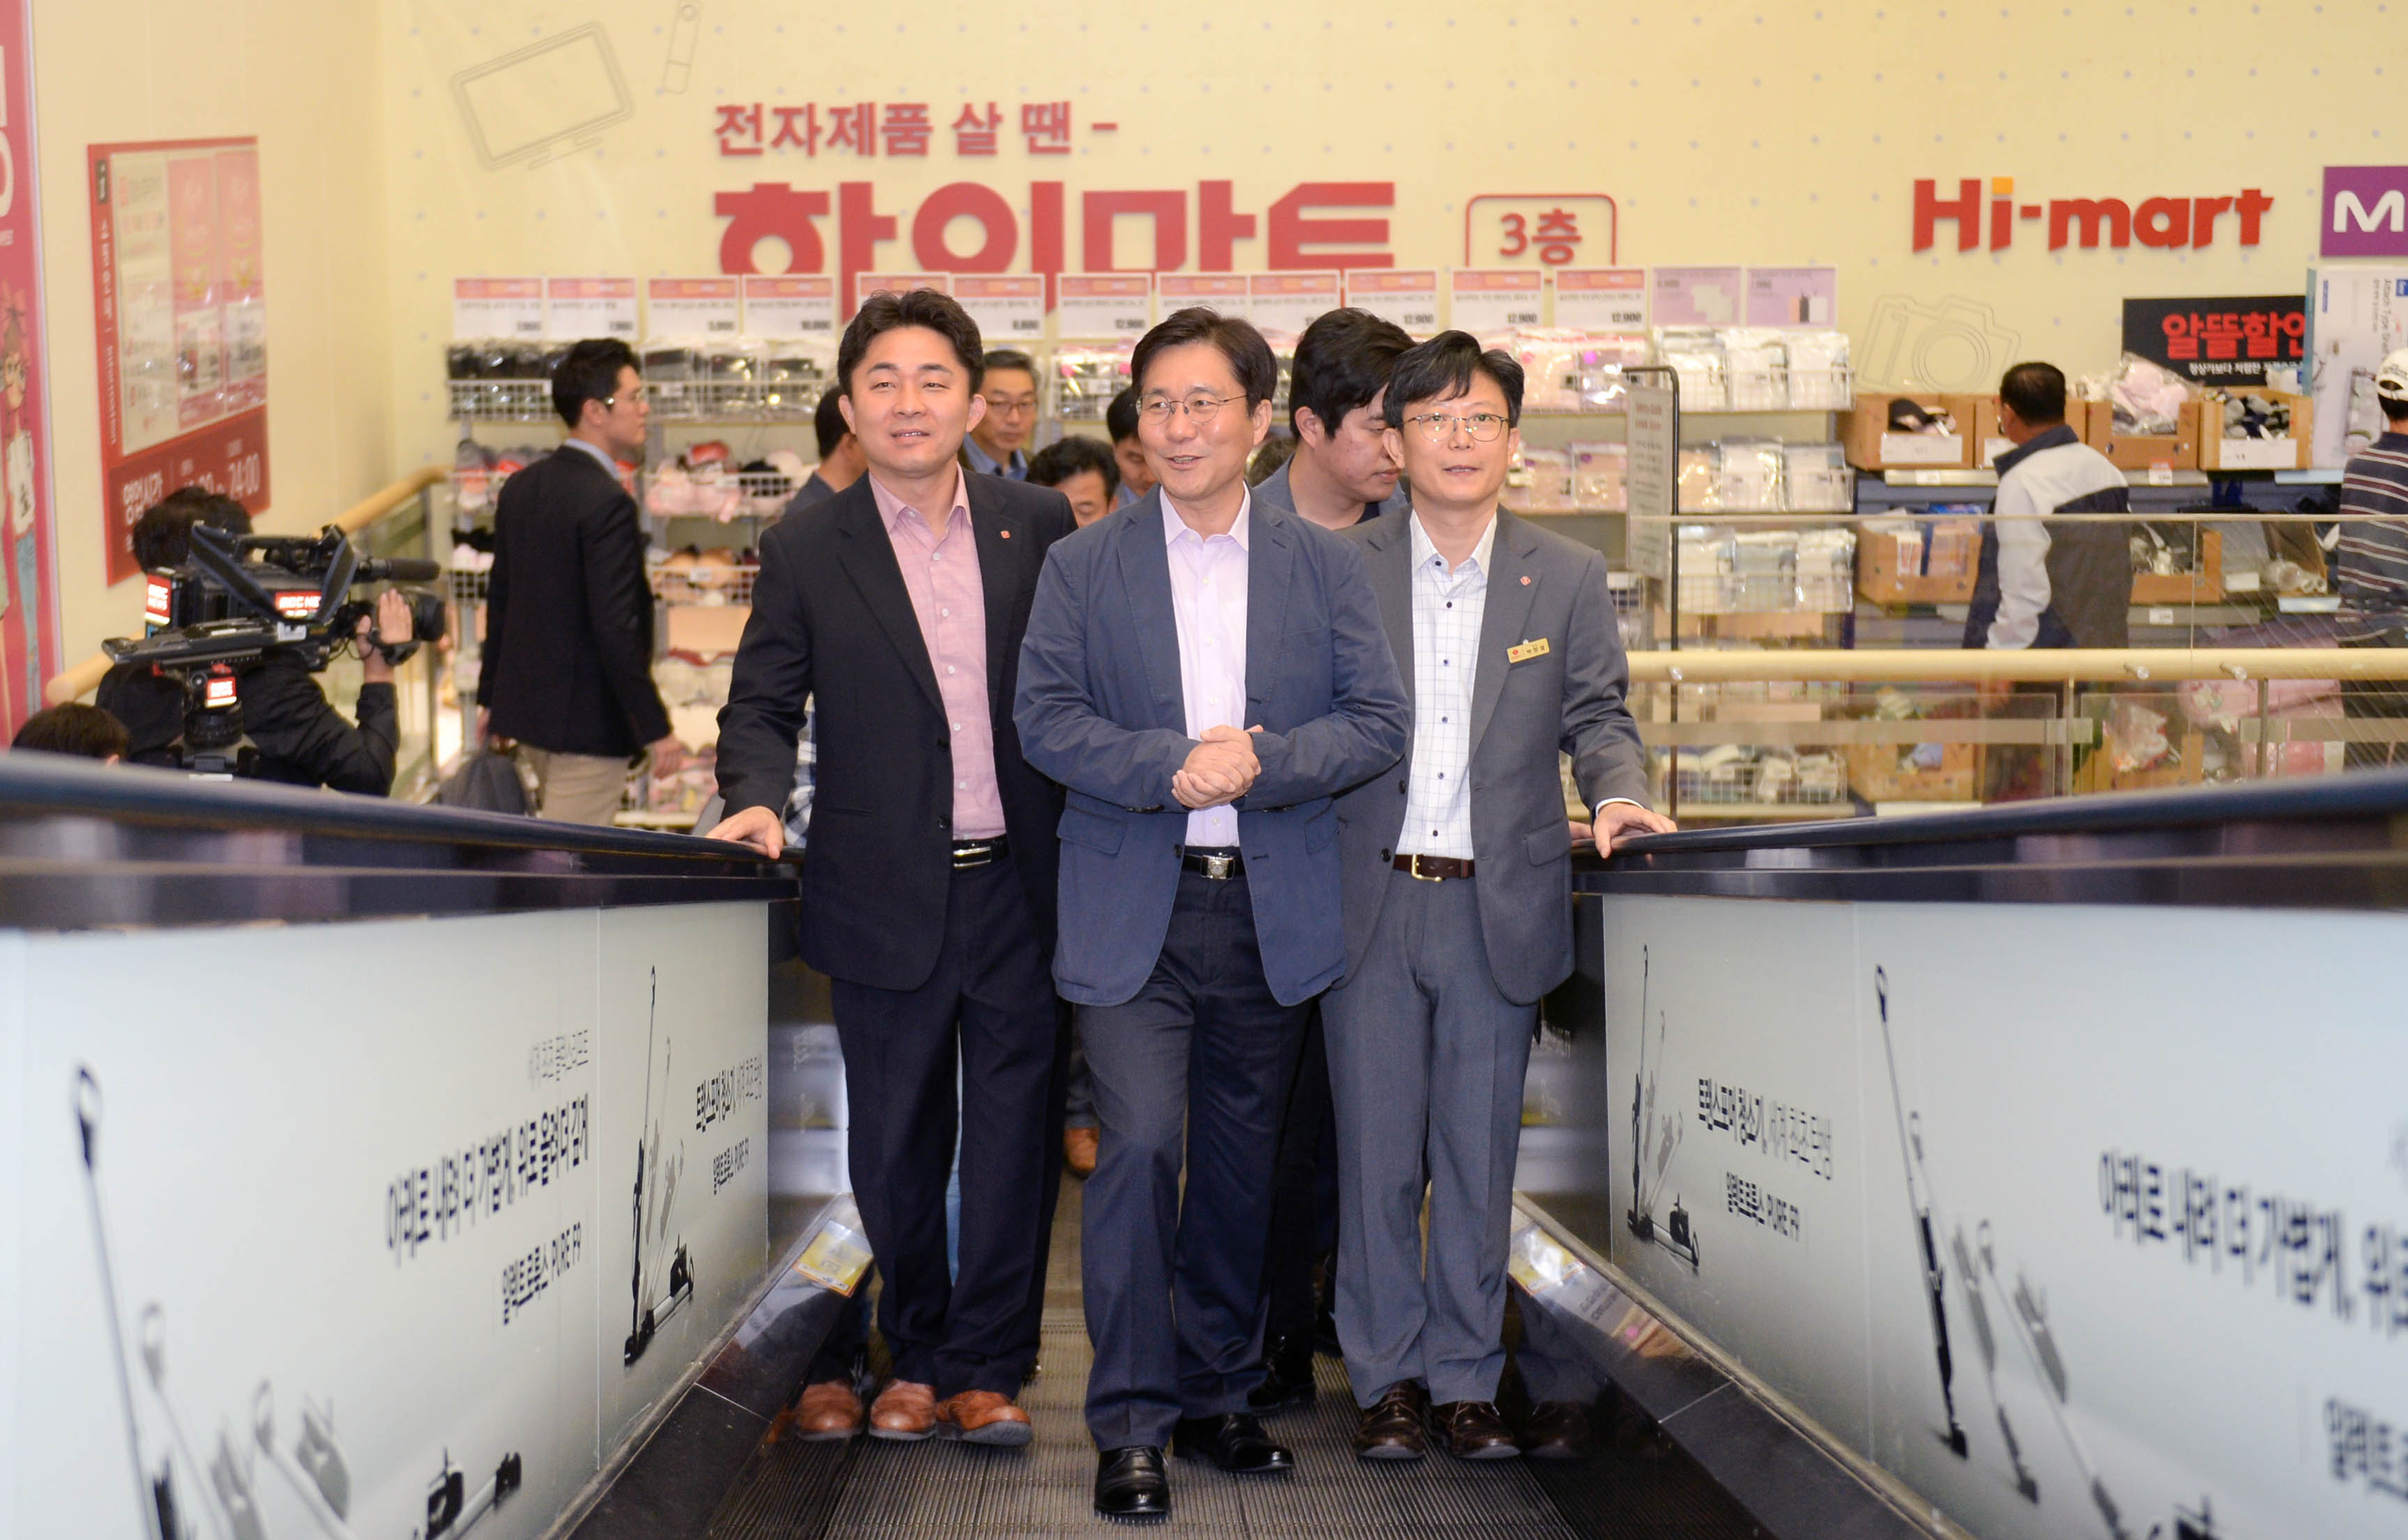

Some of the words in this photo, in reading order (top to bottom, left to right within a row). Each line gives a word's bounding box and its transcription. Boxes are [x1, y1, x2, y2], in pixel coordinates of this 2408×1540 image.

[714, 101, 934, 158] 전자제품
[952, 101, 1004, 156] 살
[1021, 101, 1072, 155] 땐
[1499, 208, 1582, 266] 3층
[1912, 176, 2274, 252] Hi-mart
[714, 180, 1395, 308] 하이마트
[2163, 311, 2306, 360] 알뜰할인
